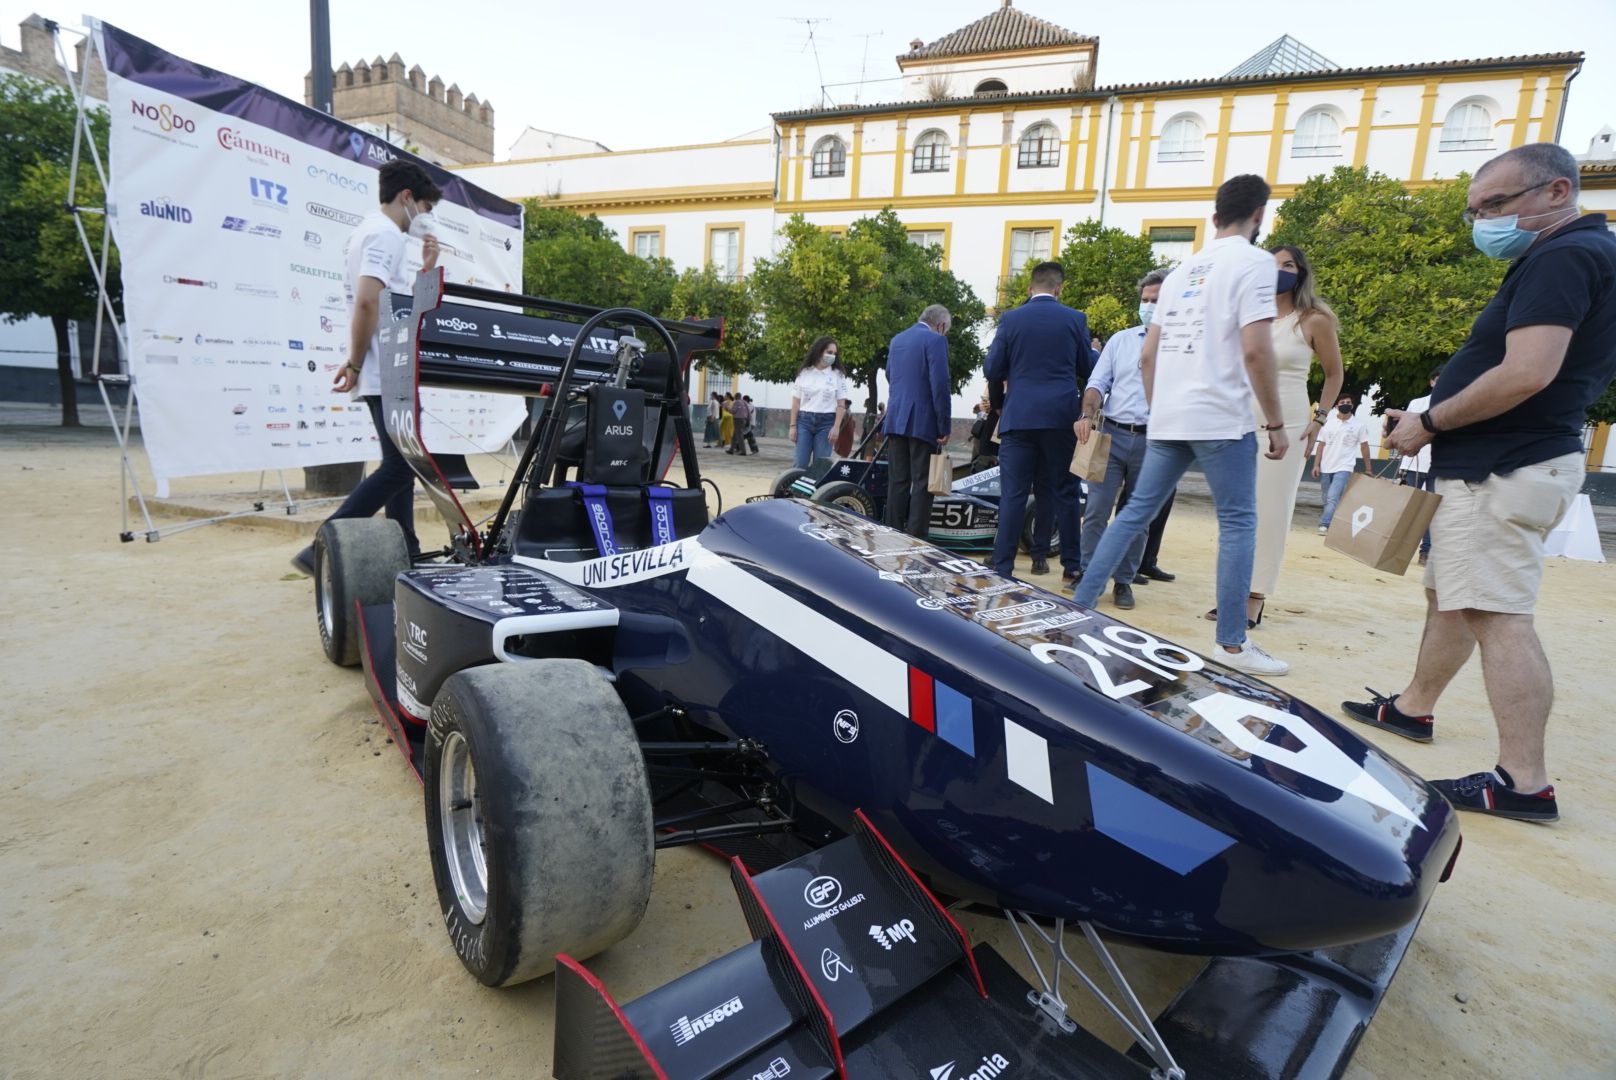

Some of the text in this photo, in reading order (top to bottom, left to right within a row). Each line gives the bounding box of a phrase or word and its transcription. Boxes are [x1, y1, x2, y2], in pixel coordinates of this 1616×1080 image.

[217, 127, 292, 165] Cámara
[249, 176, 288, 206] ITZ
[306, 165, 369, 194] endesa
[140, 200, 193, 224] aluNID
[290, 263, 343, 281] SCHAEFFLER
[604, 425, 633, 436] ARUS
[655, 503, 671, 546] parco
[583, 542, 684, 586] UNI SEVILLA
[410, 621, 427, 647] TRC
[1030, 625, 1205, 700] 218
[809, 880, 836, 904] GP
[803, 893, 866, 930] ALUMINIOS GALISUR
[960, 1053, 1010, 1080] ania
